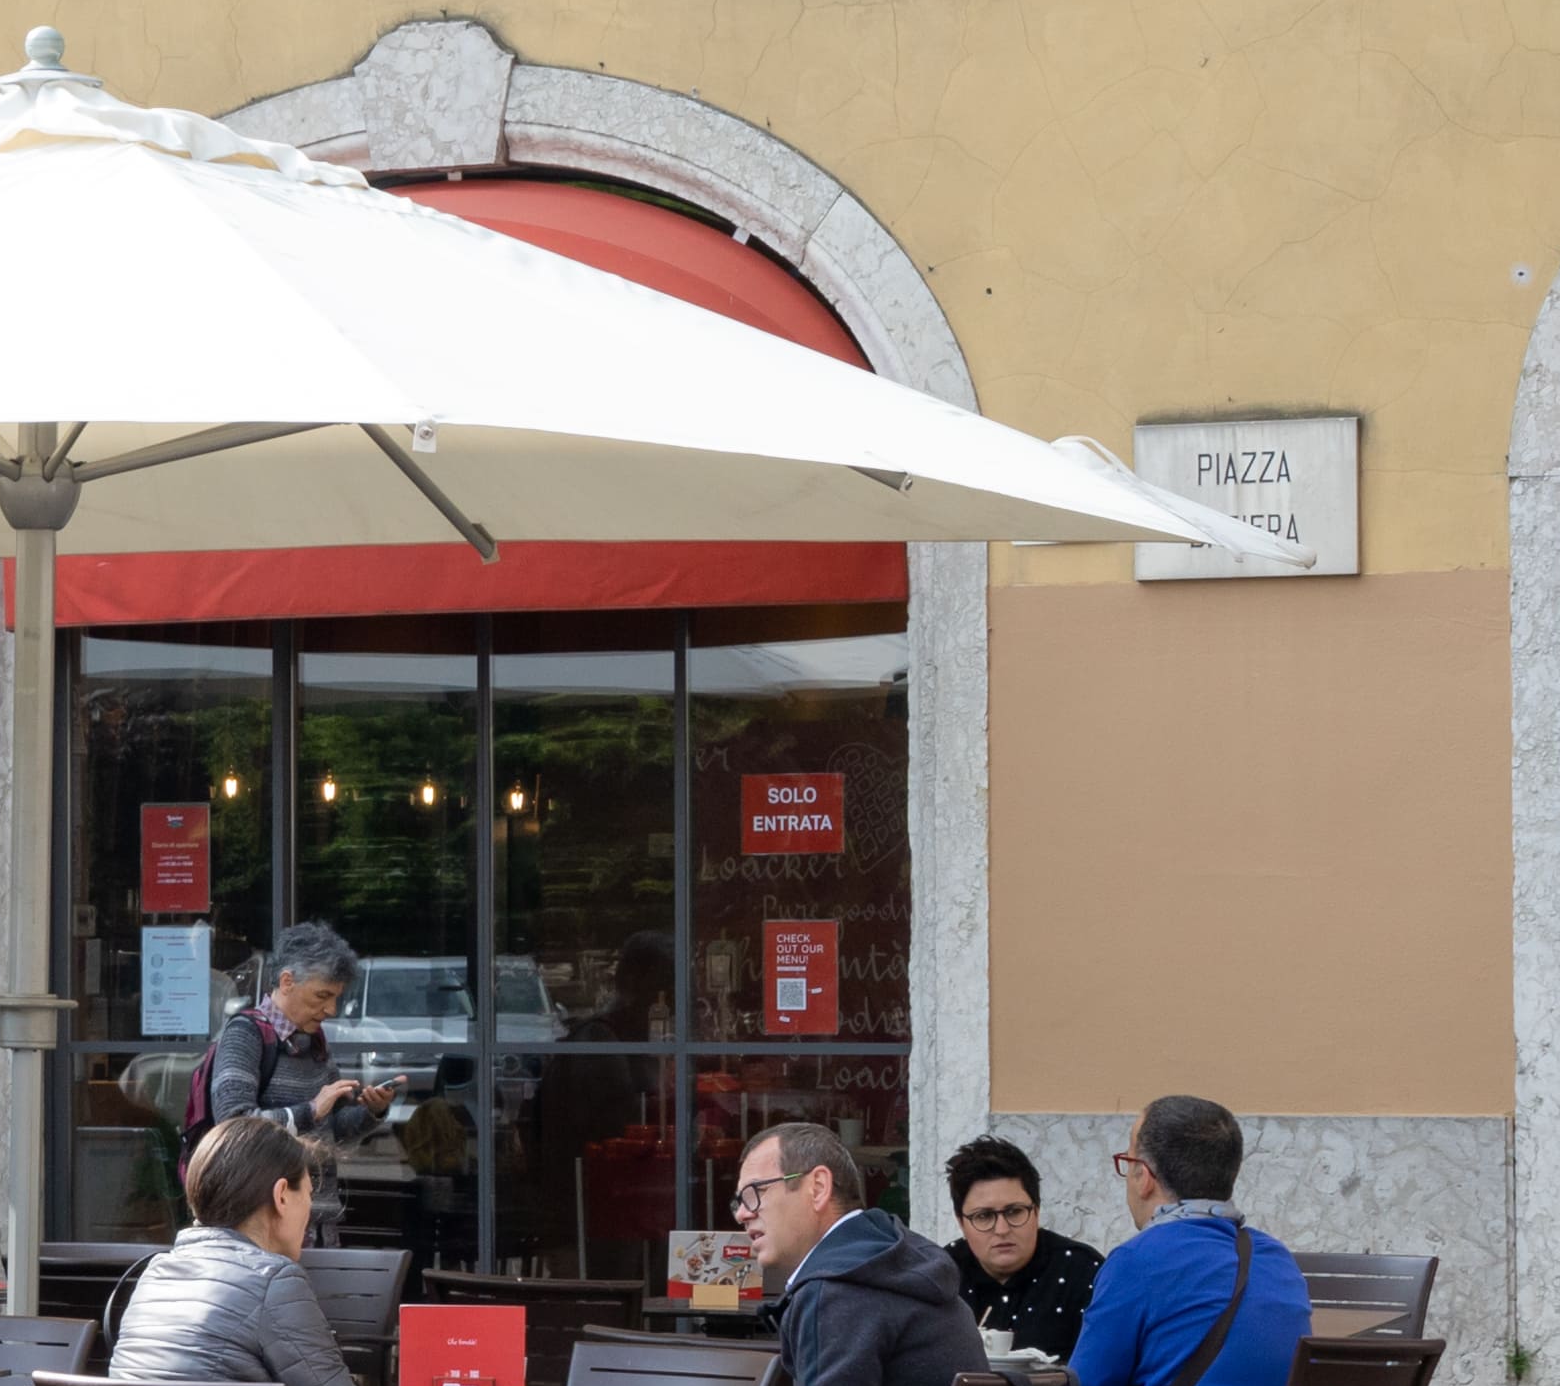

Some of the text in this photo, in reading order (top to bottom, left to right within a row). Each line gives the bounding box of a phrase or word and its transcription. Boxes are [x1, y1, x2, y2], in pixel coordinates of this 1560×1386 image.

[1198, 450, 1291, 486] PIAZZA
[767, 787, 817, 804] SOLO
[752, 814, 833, 832] ENTRATA
[698, 845, 847, 883] Loacker
[776, 934, 811, 943] CHECK
[776, 944, 824, 954] OUT OUR
[776, 955, 809, 964] MENU!
